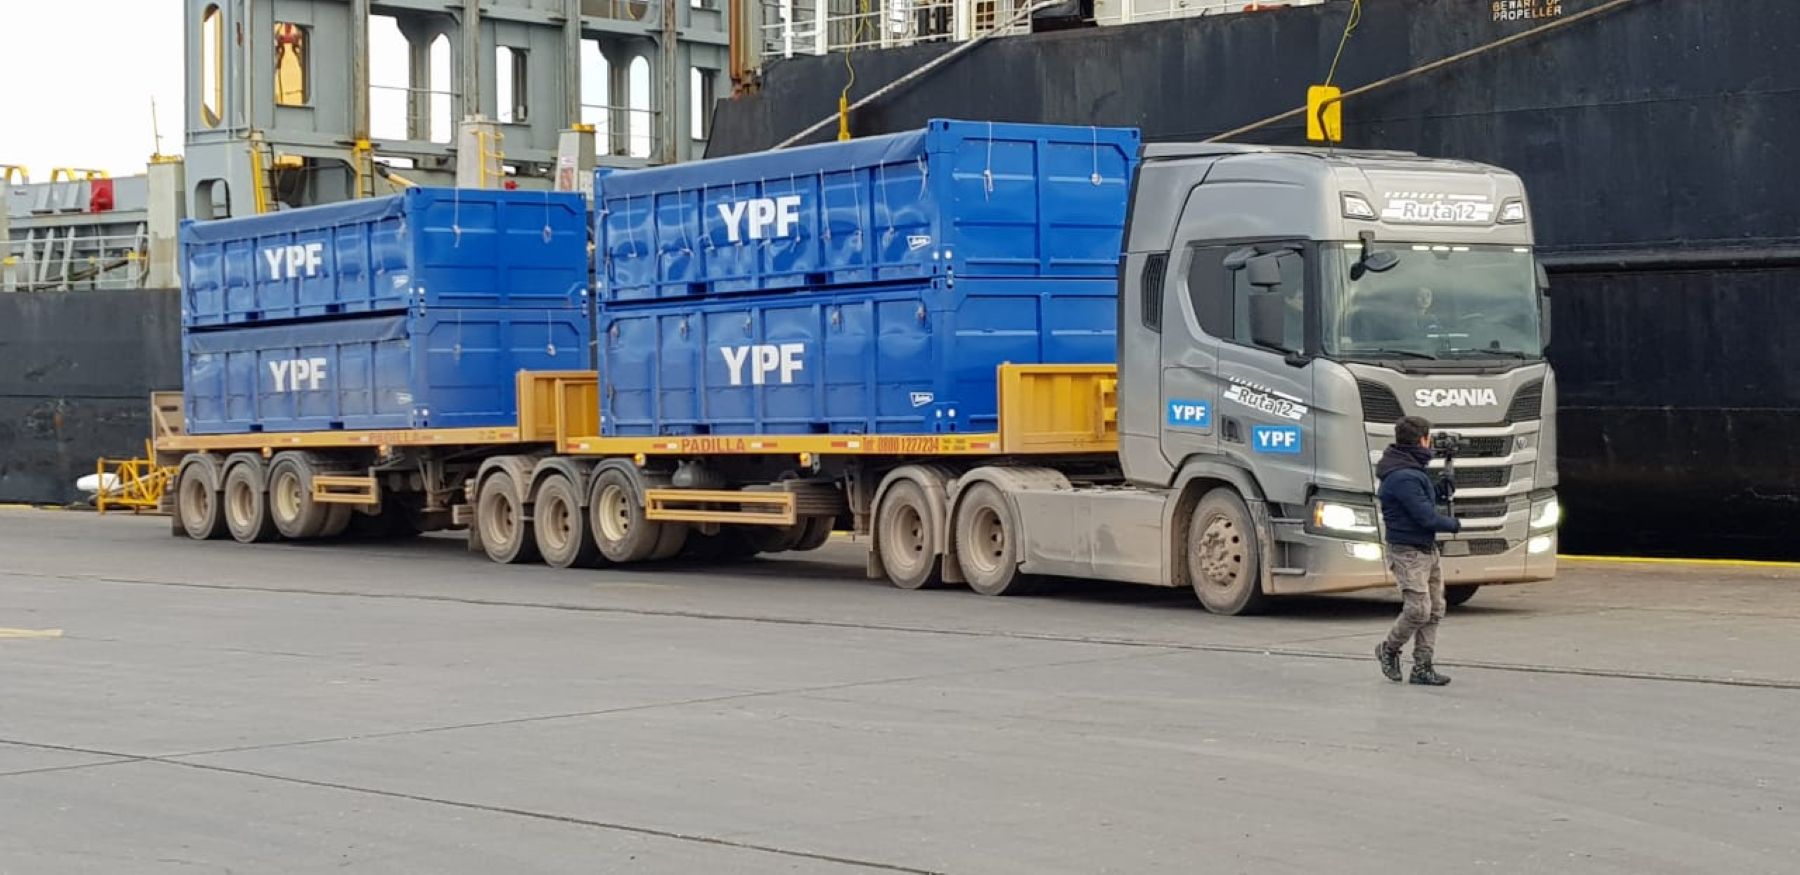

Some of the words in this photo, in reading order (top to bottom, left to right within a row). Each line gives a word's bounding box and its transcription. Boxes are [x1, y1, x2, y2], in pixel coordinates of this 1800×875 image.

[1492, 5, 1562, 21] PROPELLER
[717, 195, 801, 242] YPF
[264, 243, 323, 280] YPF
[720, 343, 805, 385] YPF
[268, 358, 327, 392] YPF
[1415, 388, 1498, 407] SCANIA
[1172, 404, 1206, 421] YPF
[681, 438, 745, 452] PADILLA
[1257, 430, 1296, 447] YPF
